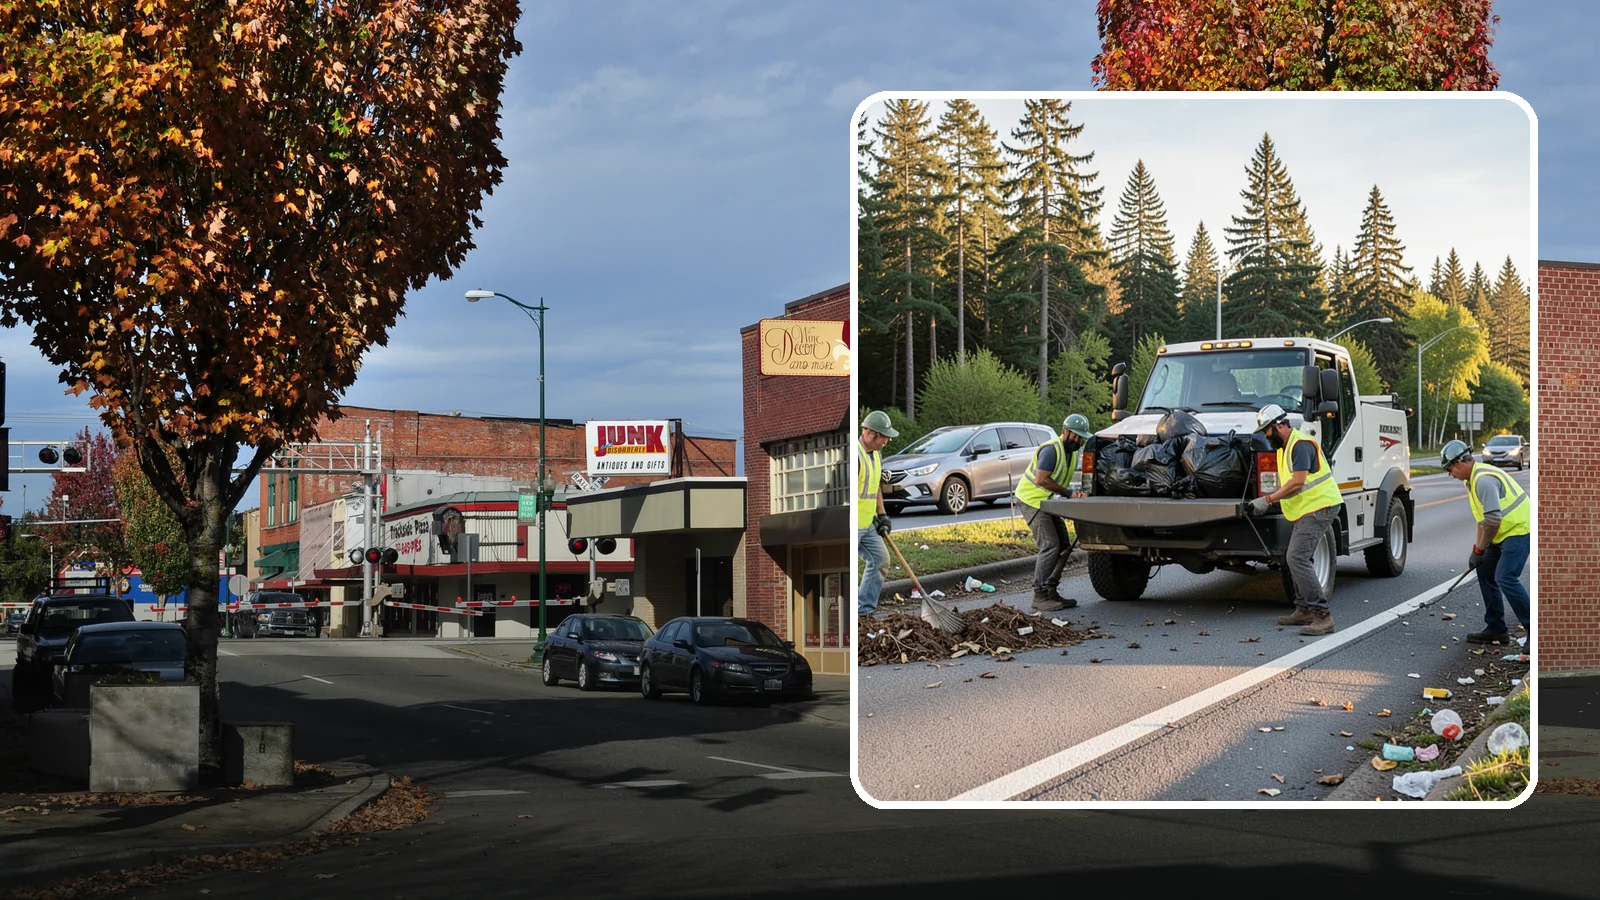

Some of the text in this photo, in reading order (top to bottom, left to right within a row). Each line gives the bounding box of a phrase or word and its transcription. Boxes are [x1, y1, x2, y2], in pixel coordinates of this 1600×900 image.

[595, 425, 665, 457] JUNK
[597, 461, 665, 470] ANTIQUES AND GIFTS
[414, 519, 429, 534] Pizza
